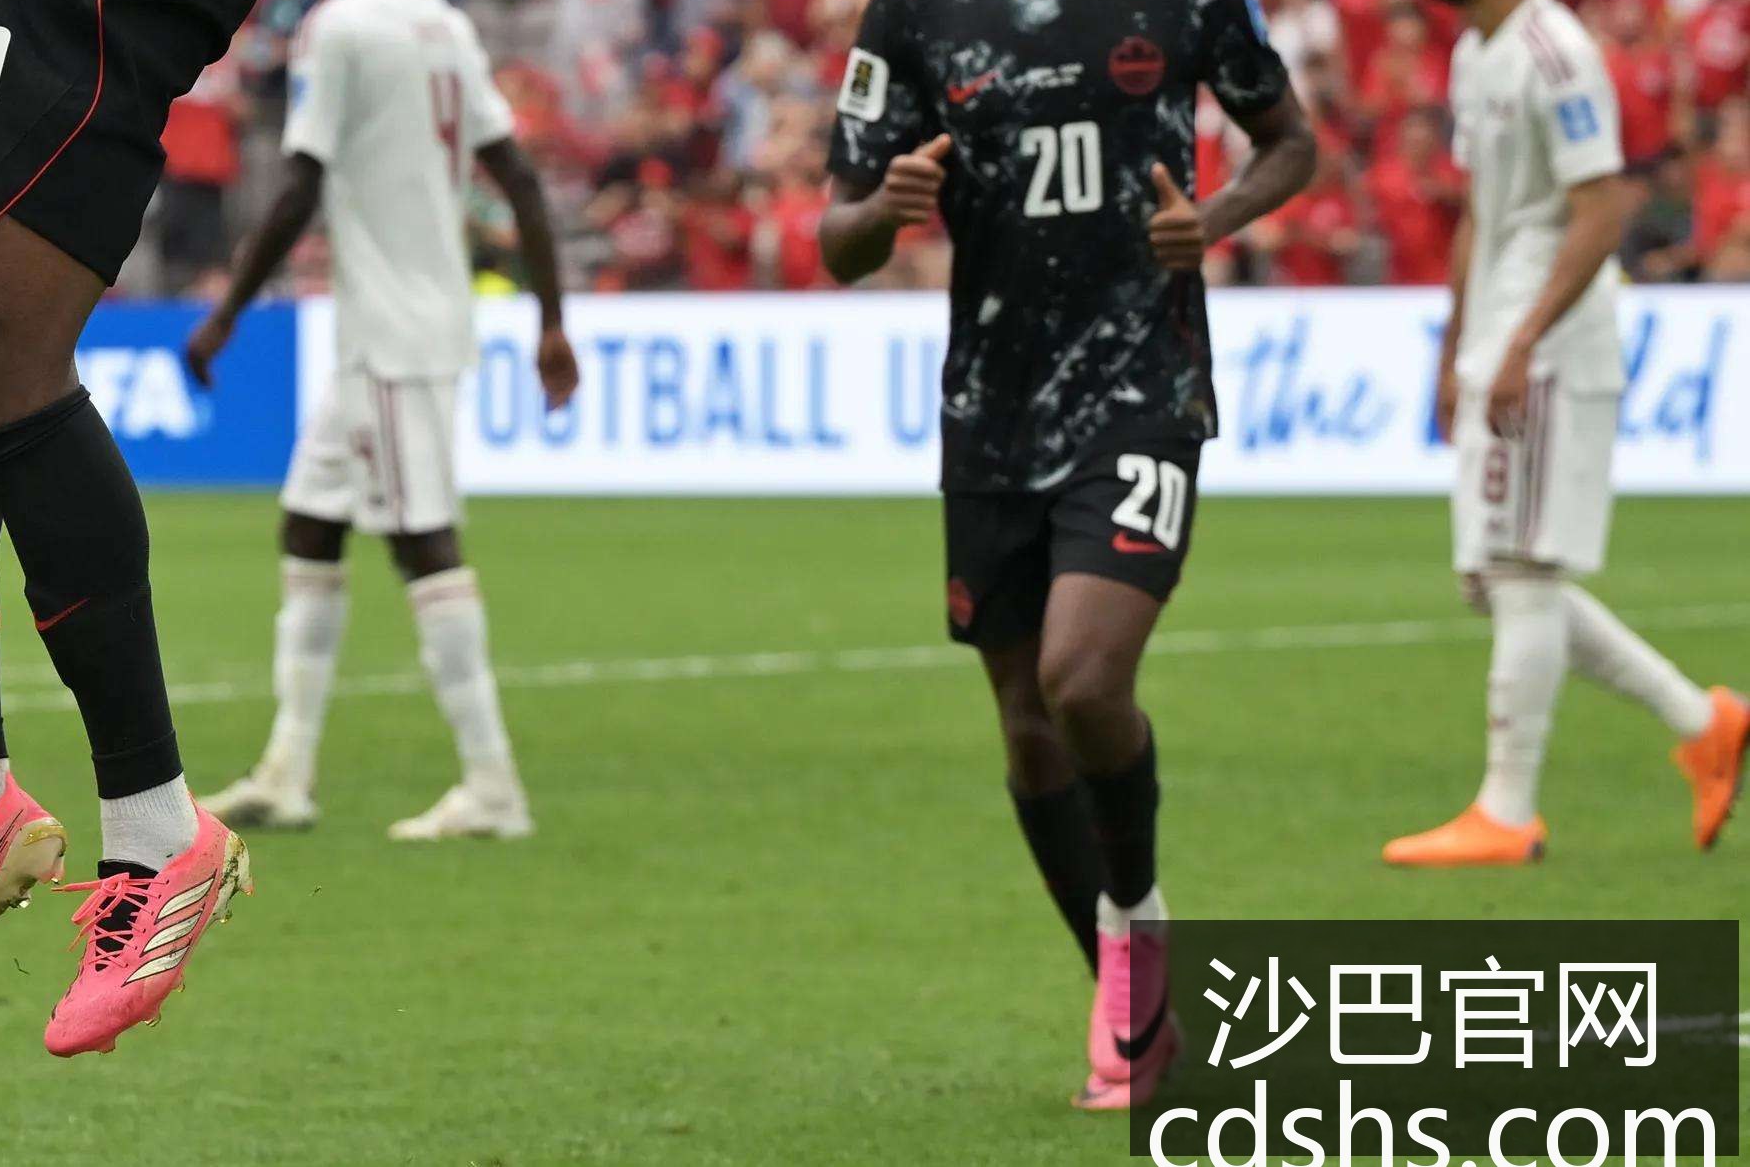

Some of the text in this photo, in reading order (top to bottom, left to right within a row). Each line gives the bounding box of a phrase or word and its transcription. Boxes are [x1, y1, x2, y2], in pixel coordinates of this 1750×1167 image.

[427, 66, 464, 185] 4
[1020, 121, 1103, 218] 20
[478, 337, 845, 447] OTBALL
[1228, 317, 1393, 451] the
[1111, 453, 1188, 551] 20
